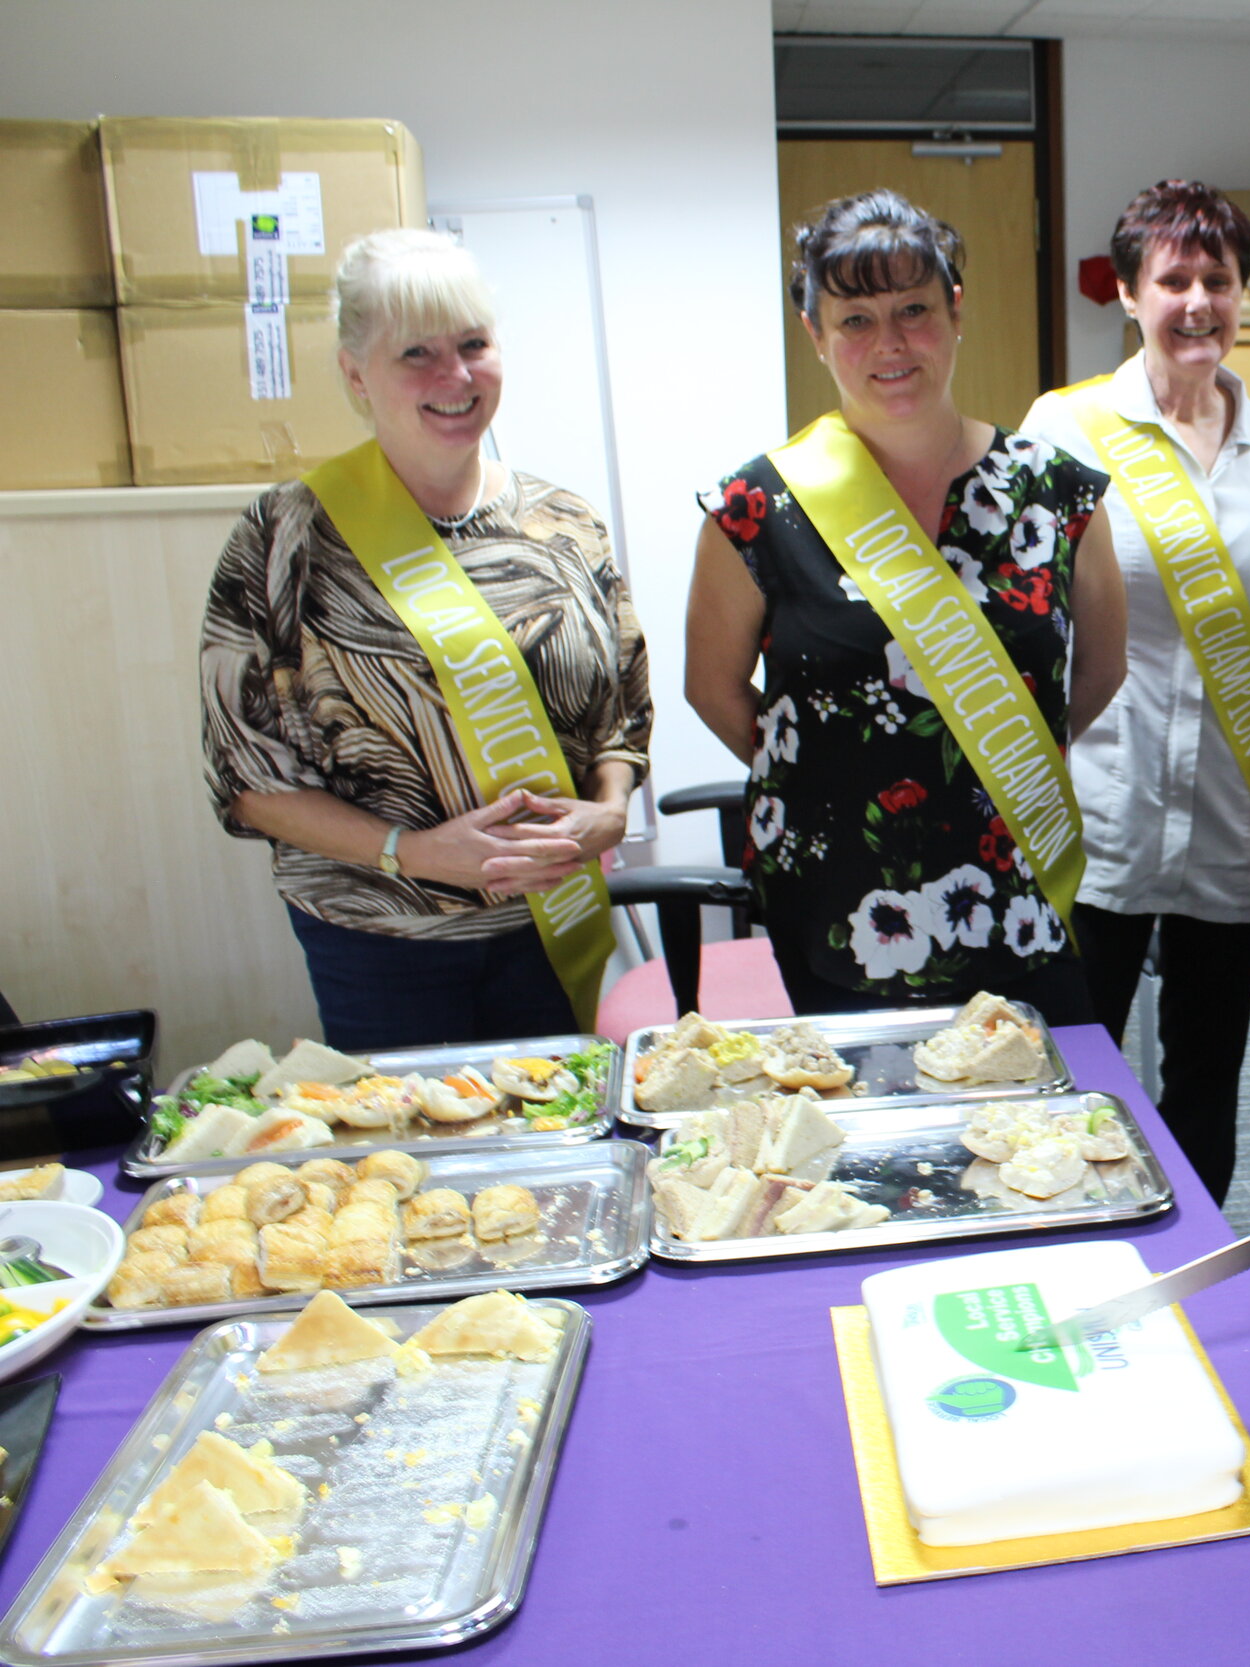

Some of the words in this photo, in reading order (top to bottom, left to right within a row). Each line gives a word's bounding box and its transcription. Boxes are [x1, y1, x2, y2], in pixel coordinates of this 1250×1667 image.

[1100, 422, 1180, 515] LOCAL
[1145, 499, 1234, 614] SERVICE
[381, 545, 484, 648] LOCAL
[443, 637, 548, 781] SERVICE
[844, 508, 942, 612] LOCAL
[903, 596, 1016, 731] SERVICE
[977, 714, 1077, 871] CHAMPION
[955, 1291, 989, 1330] Local
[986, 1288, 1020, 1342] Service
[1011, 1285, 1056, 1364] Cmpions
